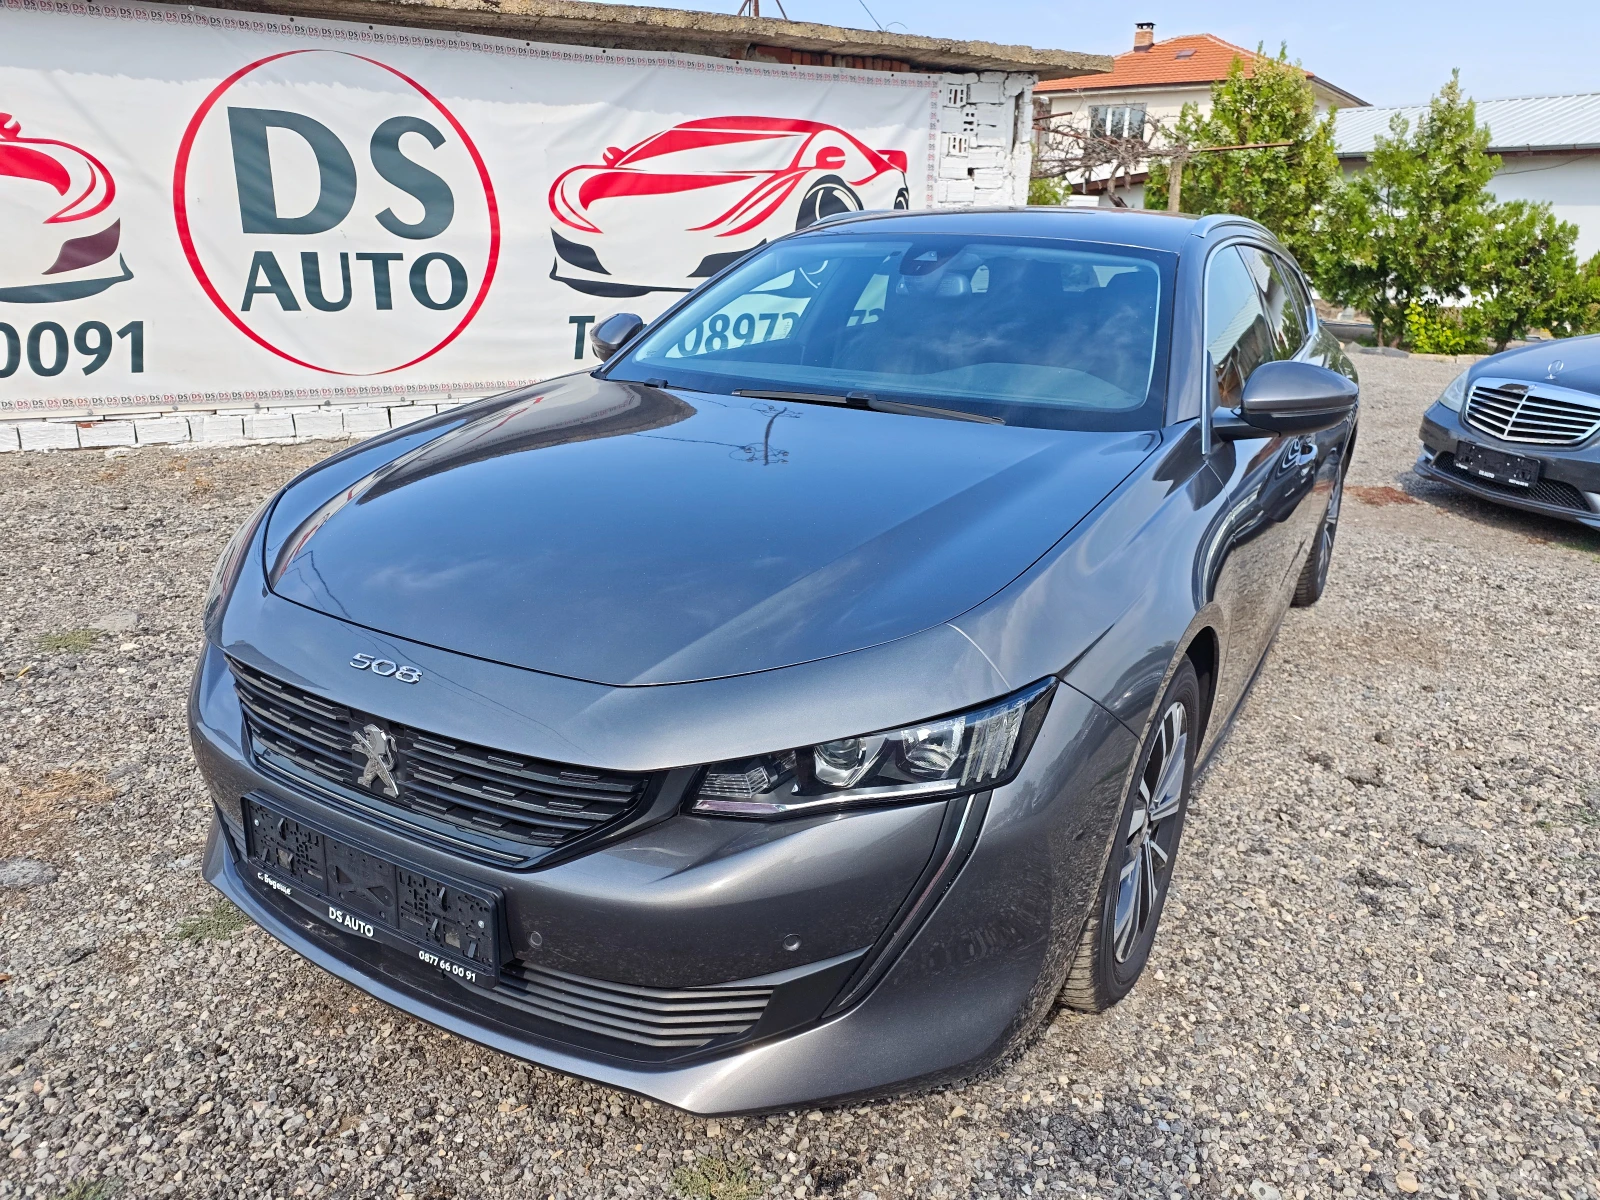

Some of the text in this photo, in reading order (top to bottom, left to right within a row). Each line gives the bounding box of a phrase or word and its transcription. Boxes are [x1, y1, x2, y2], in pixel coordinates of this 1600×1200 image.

[227, 106, 454, 240] DS
[240, 250, 468, 312] AUTO
[350, 652, 423, 684] 508
[328, 906, 374, 937] DS AUTO
[418, 950, 476, 982] 0877 66 00 91
